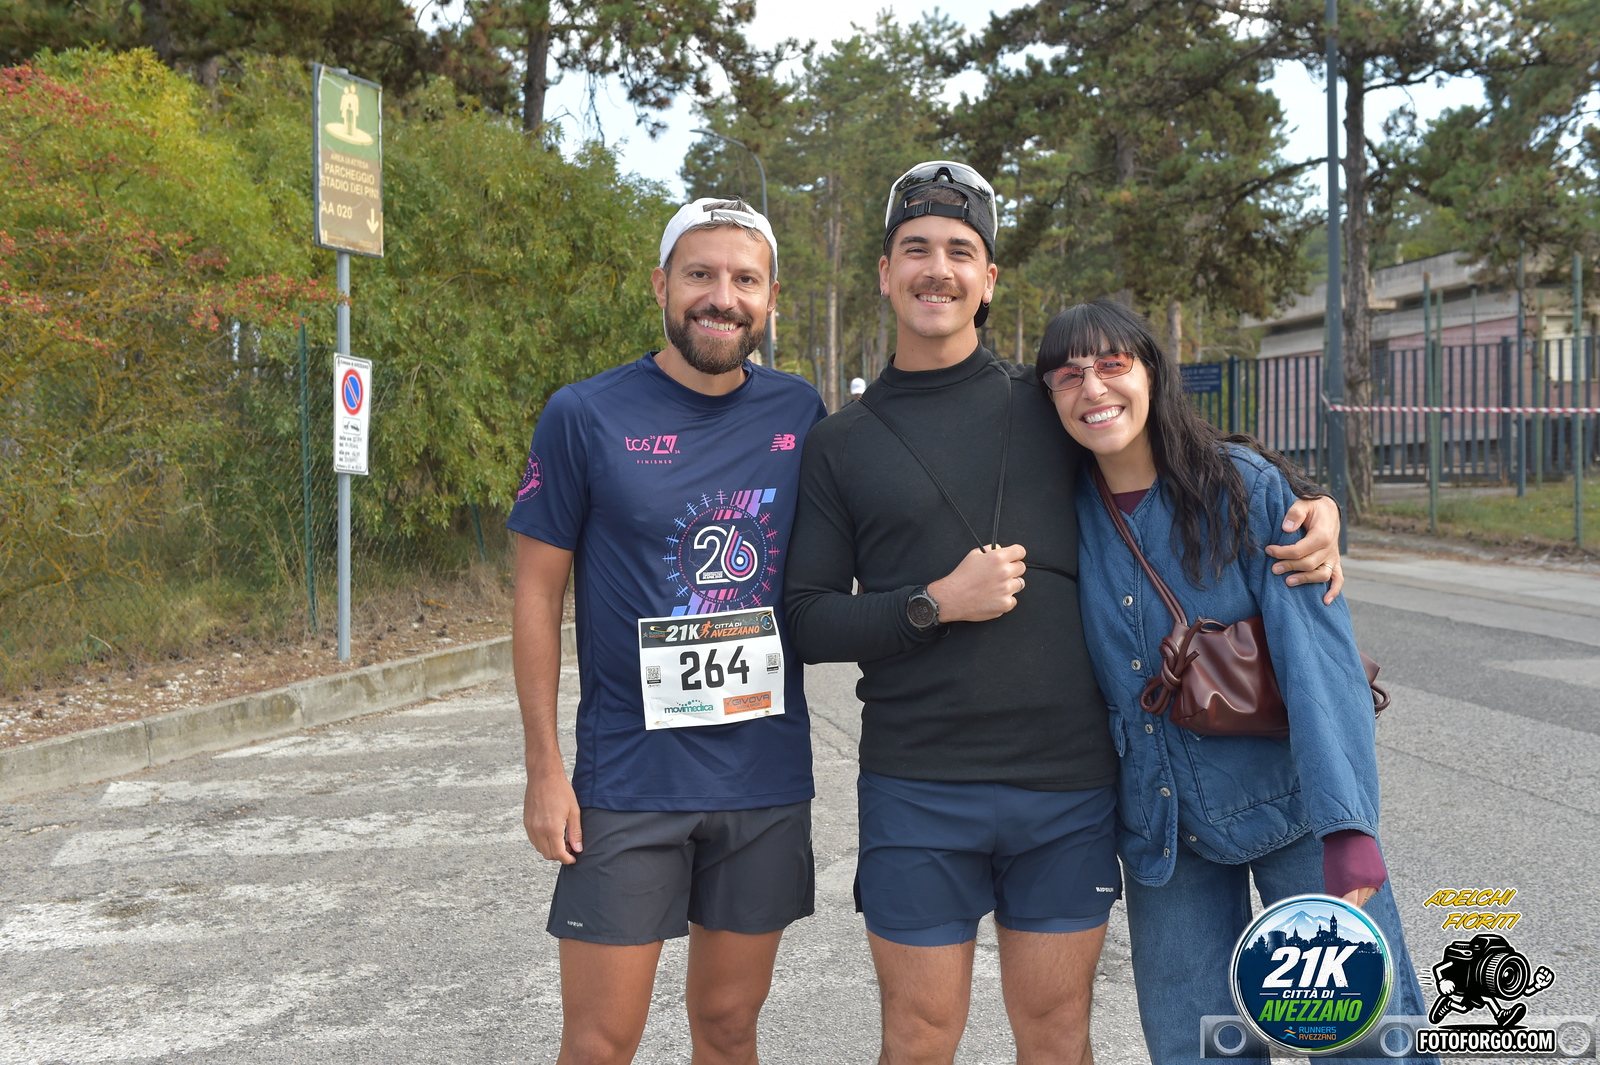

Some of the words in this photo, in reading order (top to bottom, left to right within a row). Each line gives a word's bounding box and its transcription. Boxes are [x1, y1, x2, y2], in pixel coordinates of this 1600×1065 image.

[324, 162, 375, 185] PARCHEGGIO
[320, 175, 349, 192] STADIO
[350, 182, 363, 196] DEI
[321, 201, 335, 216] AA
[336, 204, 353, 220] 020
[625, 436, 651, 451] tcs
[694, 525, 758, 584] 26
[665, 624, 700, 642] 21K
[680, 645, 749, 691] 264
[664, 703, 714, 714] movimedica
[732, 694, 771, 706] GIVOVA
